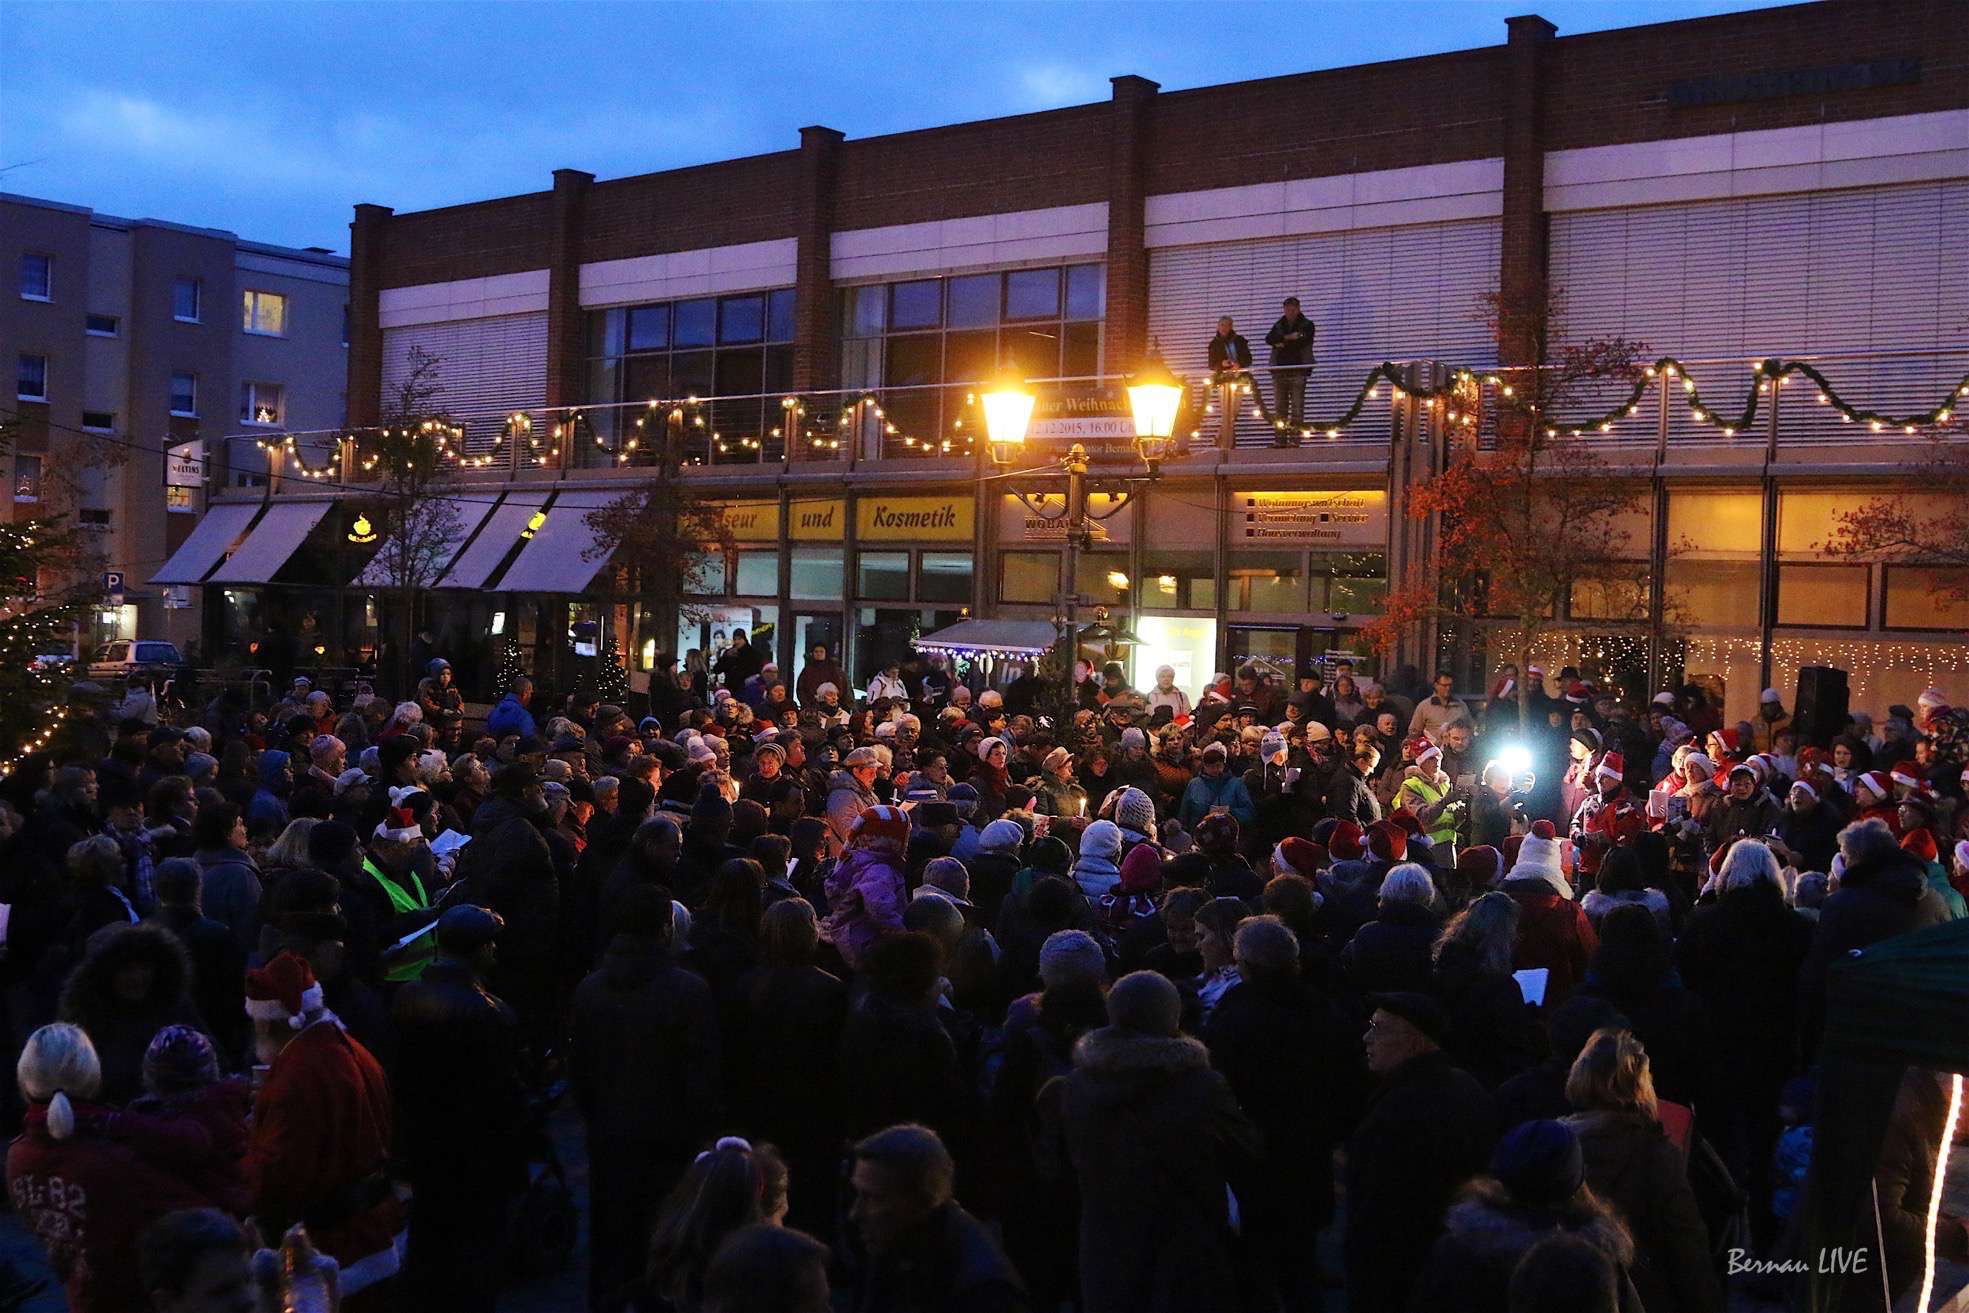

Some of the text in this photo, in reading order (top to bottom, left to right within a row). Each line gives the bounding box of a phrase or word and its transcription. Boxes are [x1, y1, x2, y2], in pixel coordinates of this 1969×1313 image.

[801, 506, 834, 528] und
[873, 506, 956, 528] Kosmetik
[108, 574, 120, 589] P
